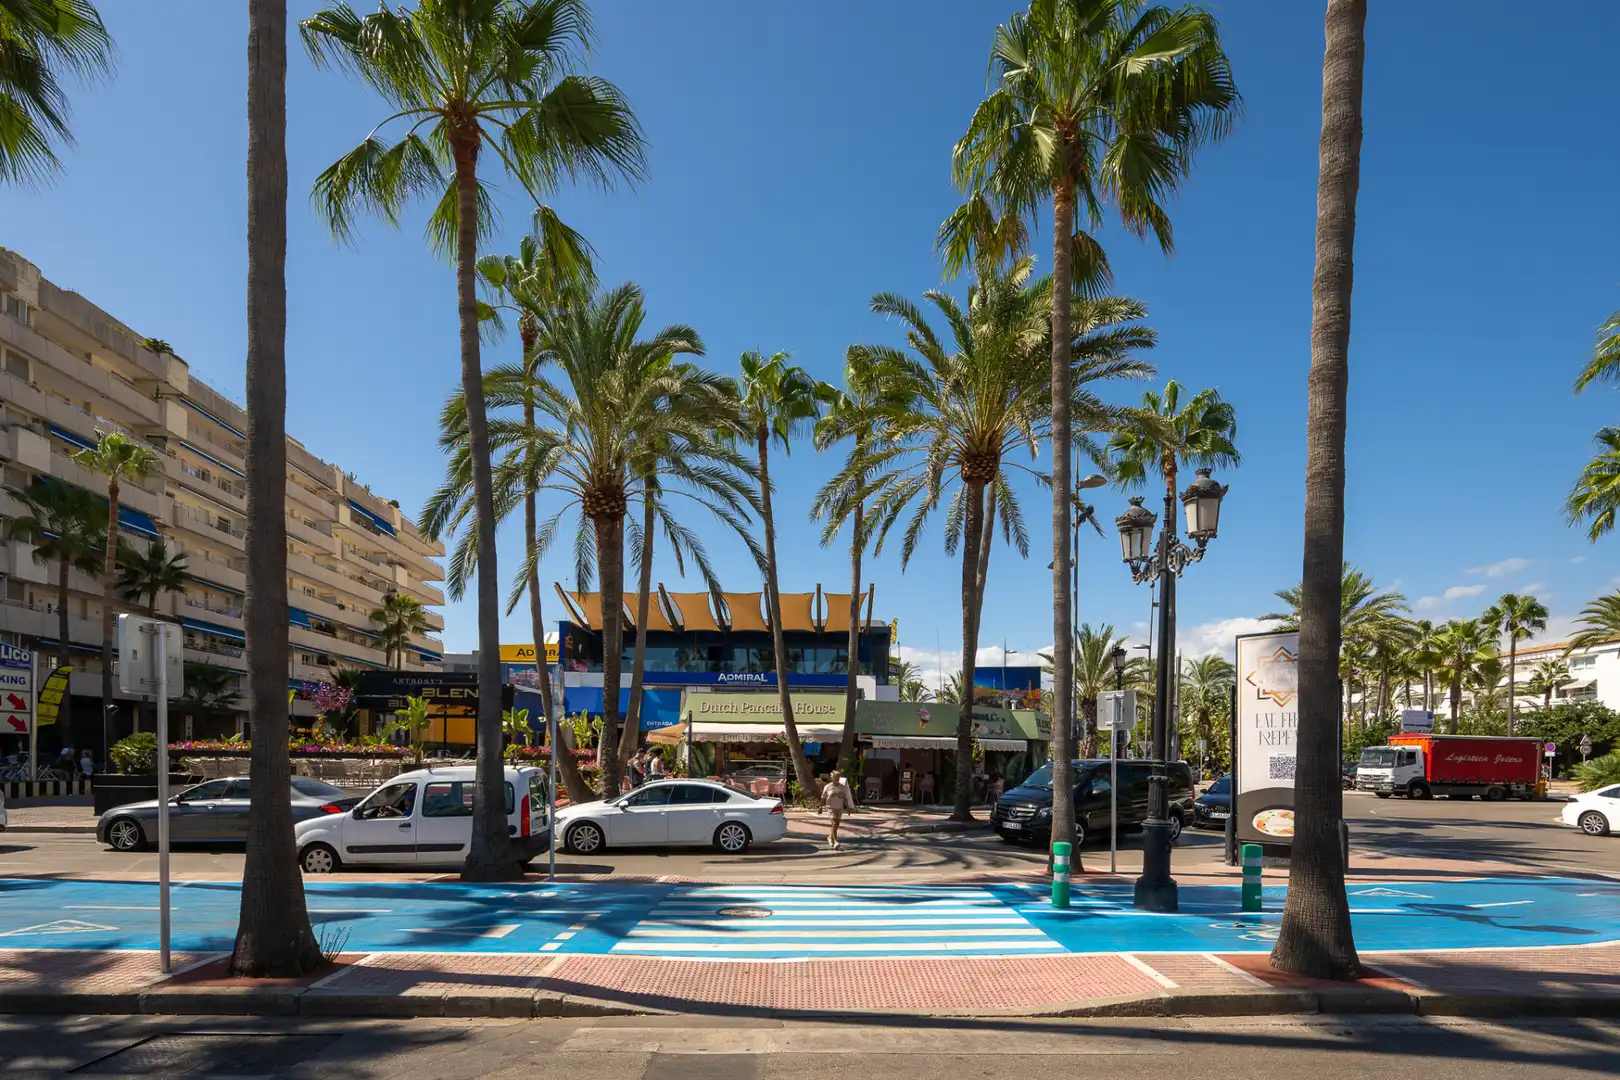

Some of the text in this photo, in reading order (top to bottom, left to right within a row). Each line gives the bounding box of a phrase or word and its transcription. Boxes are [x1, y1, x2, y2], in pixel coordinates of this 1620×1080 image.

[0, 645, 29, 661] LICO
[0, 674, 26, 685] KING
[392, 677, 443, 685] ANTHONY'S
[717, 672, 768, 682] ADMIRAL
[421, 687, 479, 698] BLEN
[700, 702, 836, 714] Dutch Pancak House
[1259, 730, 1298, 746] REPE
